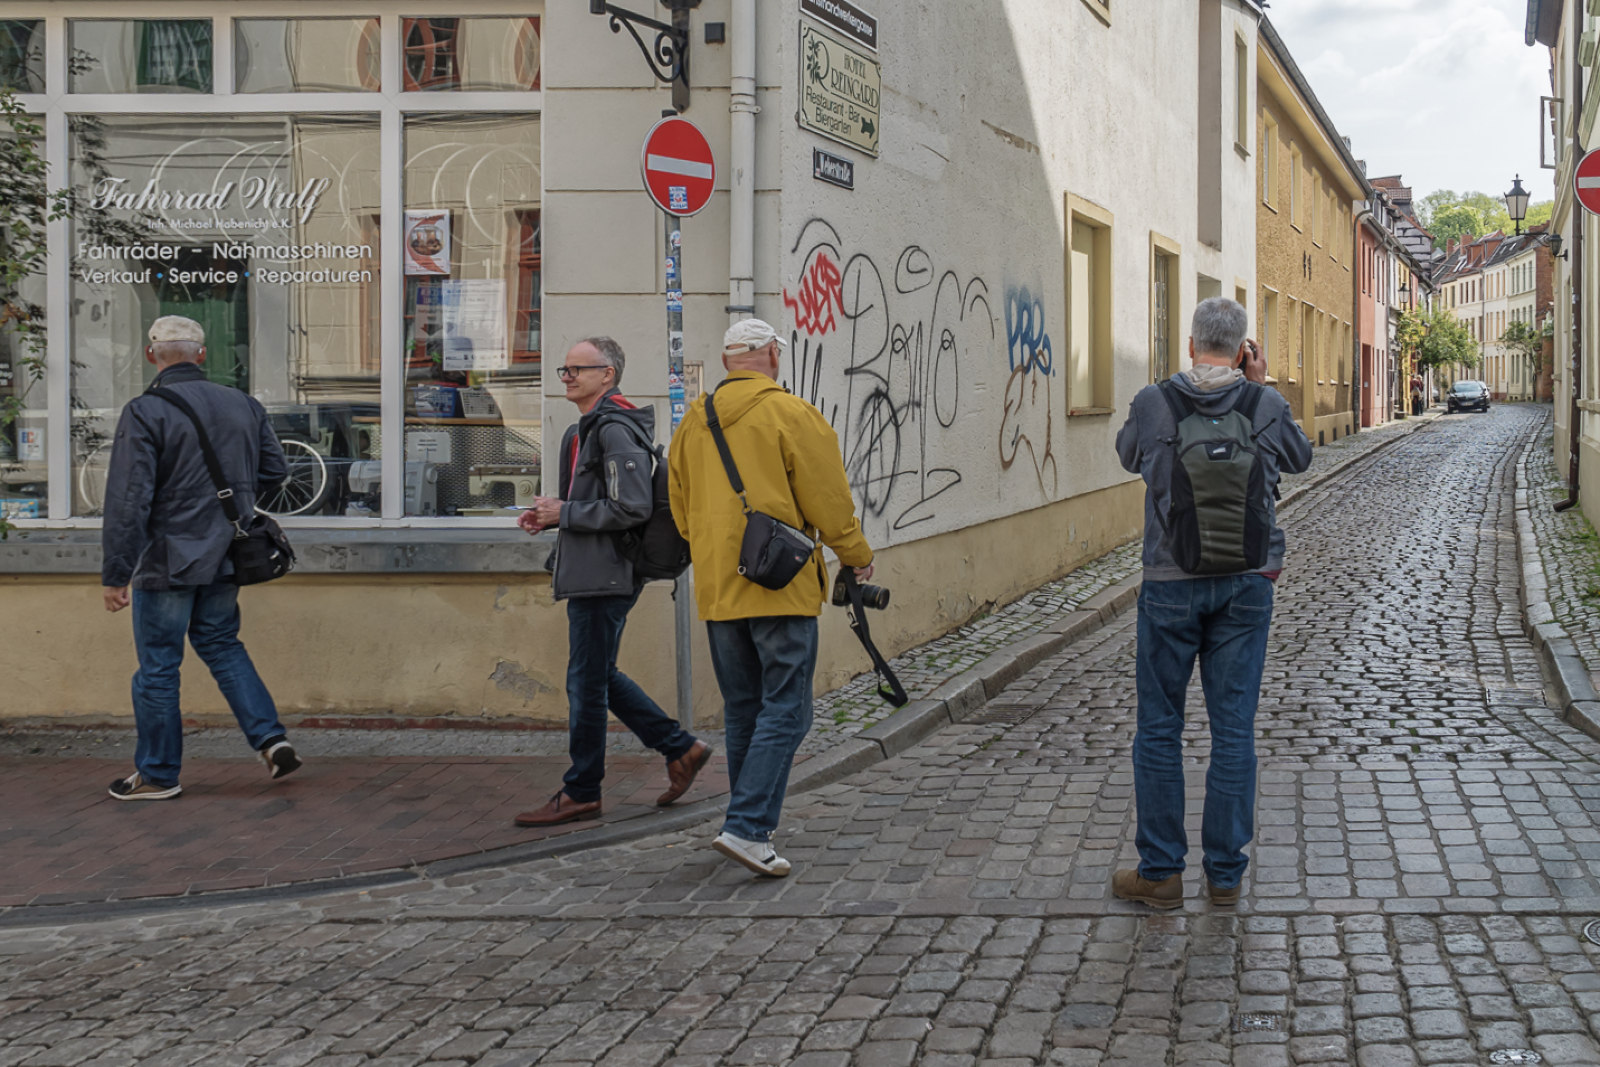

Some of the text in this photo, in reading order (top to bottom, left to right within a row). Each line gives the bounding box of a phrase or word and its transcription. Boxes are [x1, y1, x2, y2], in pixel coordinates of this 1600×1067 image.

[844, 53, 866, 79] HOTEL
[831, 67, 879, 108] REINGARD
[806, 85, 860, 123] Restaurant Bar
[815, 106, 852, 136] Biergarten
[91, 176, 330, 224] Fahrrad Wulf
[170, 218, 212, 229] Michael
[216, 218, 269, 230] Habenicht
[79, 242, 181, 260] Fahrräder
[213, 241, 372, 260] Nähmaschinen
[81, 267, 372, 286] Verkauf Service Reparaturen
